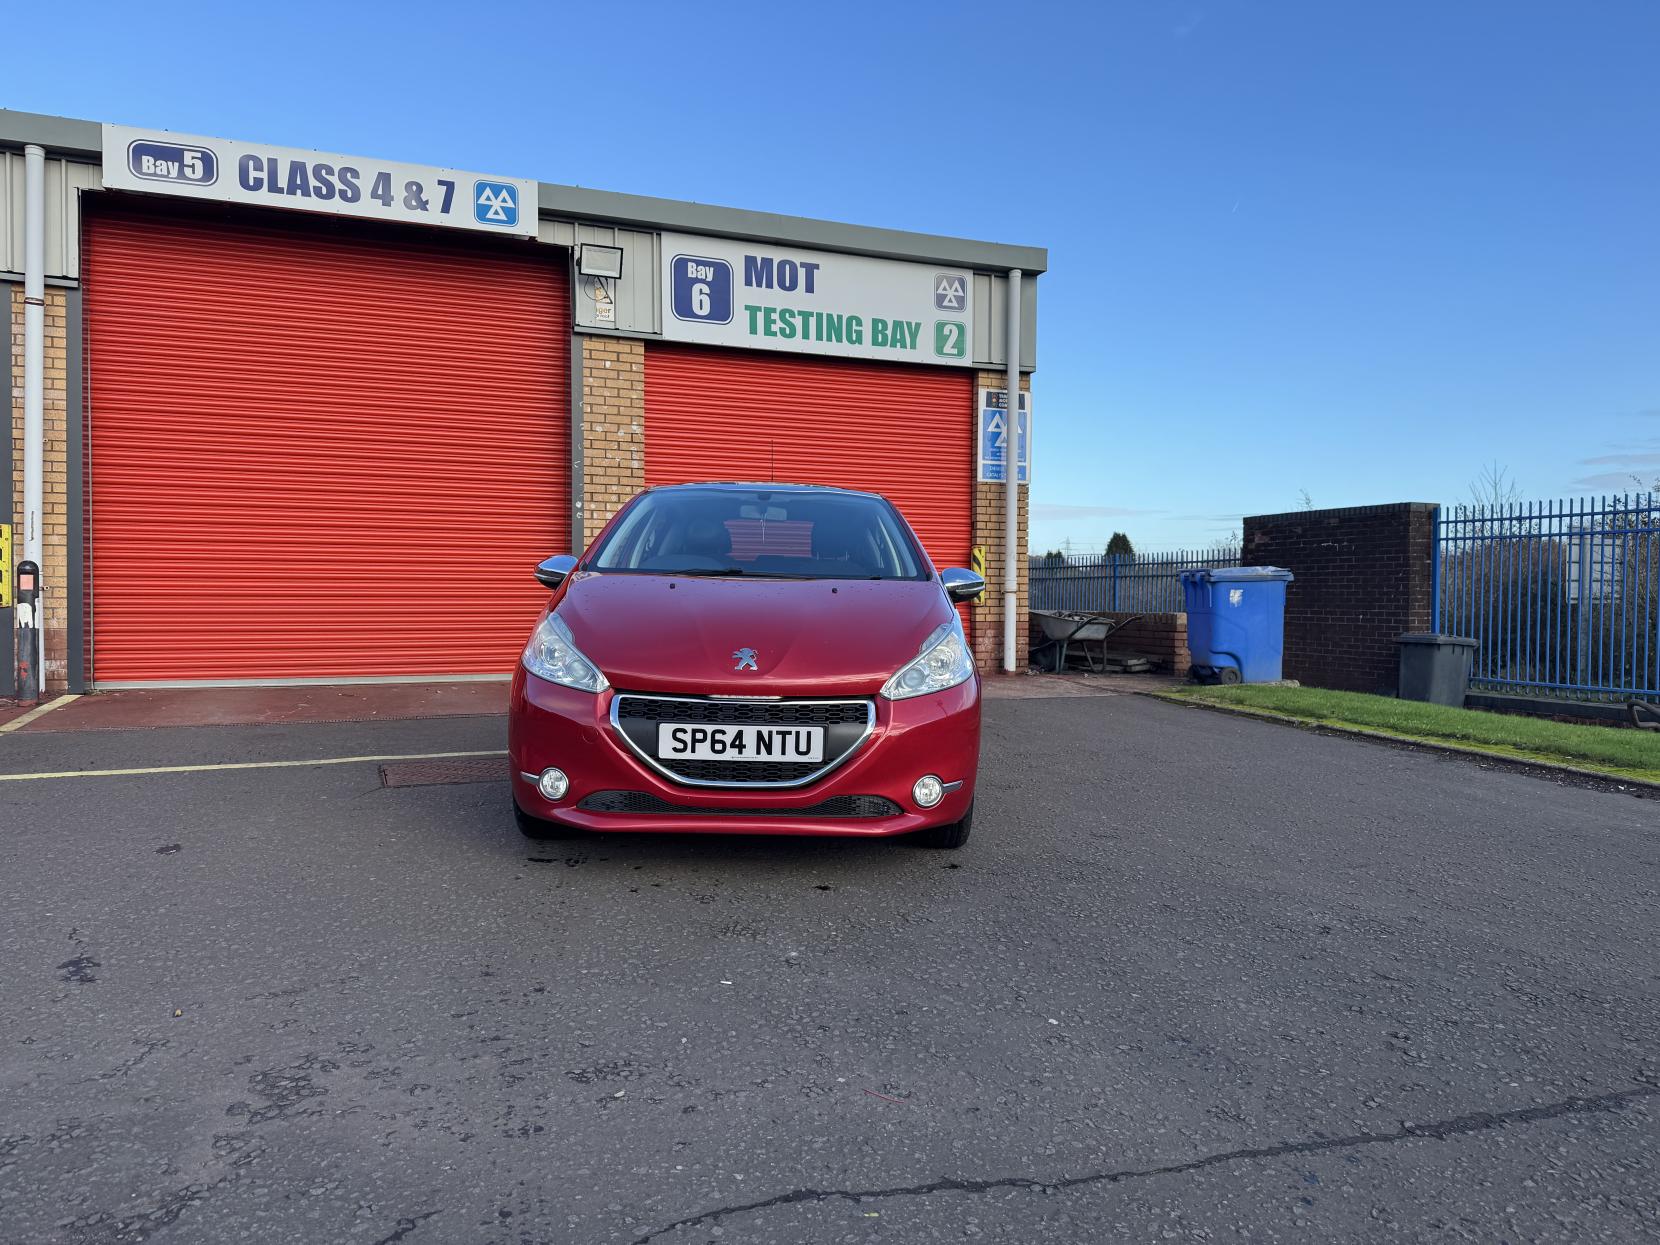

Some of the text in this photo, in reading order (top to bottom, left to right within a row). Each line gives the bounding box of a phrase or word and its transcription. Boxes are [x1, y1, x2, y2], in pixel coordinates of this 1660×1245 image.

[140, 150, 204, 180] Bay 5
[238, 154, 456, 214] CLASS 4 & 7
[687, 261, 714, 282] Bay
[744, 254, 820, 294] MOT
[691, 282, 711, 316] 6
[744, 304, 922, 350] TESTING BAY
[942, 323, 958, 355] 2
[671, 727, 812, 756] SP64 NTU
